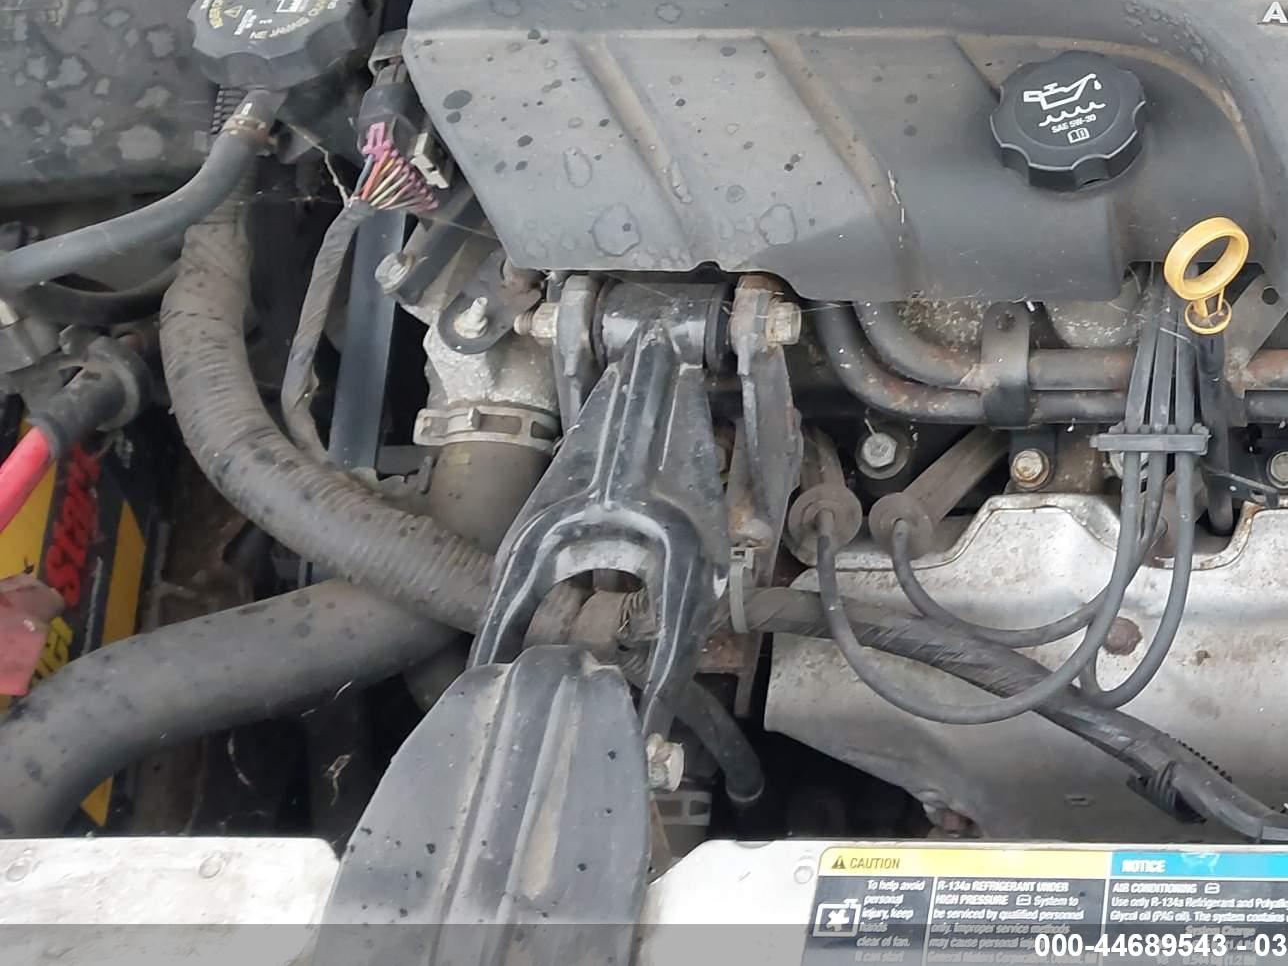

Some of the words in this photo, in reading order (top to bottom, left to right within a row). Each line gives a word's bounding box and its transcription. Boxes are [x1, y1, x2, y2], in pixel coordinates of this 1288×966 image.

[1051, 123, 1069, 133] SAE
[850, 857, 900, 869] CAUTION
[1122, 860, 1165, 872] NOTICE
[1037, 882, 1069, 892] UNDER
[936, 894, 958, 905] HIGH
[960, 894, 1009, 906] PRESSURE
[1034, 895, 1068, 908] System
[1112, 898, 1128, 907] Use
